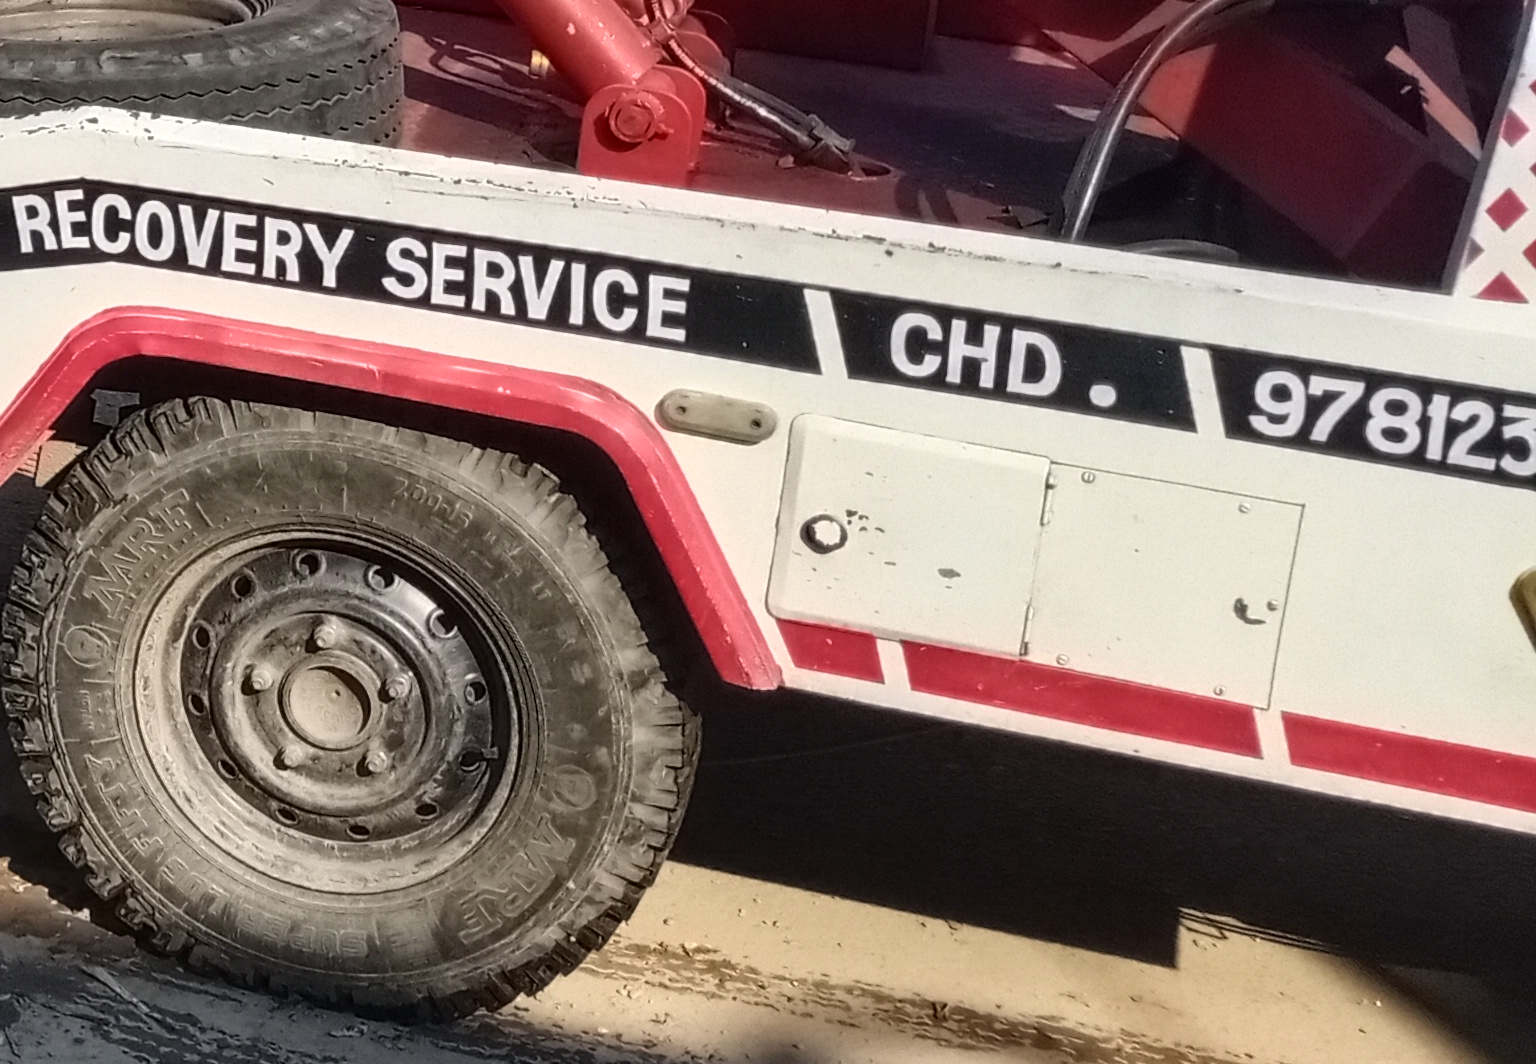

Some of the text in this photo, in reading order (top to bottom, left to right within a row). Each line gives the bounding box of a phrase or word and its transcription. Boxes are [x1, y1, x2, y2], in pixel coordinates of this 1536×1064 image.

[12, 189, 355, 289] RECOVERY
[381, 237, 691, 343] SERVICE
[1247, 369, 1536, 477] 978123
